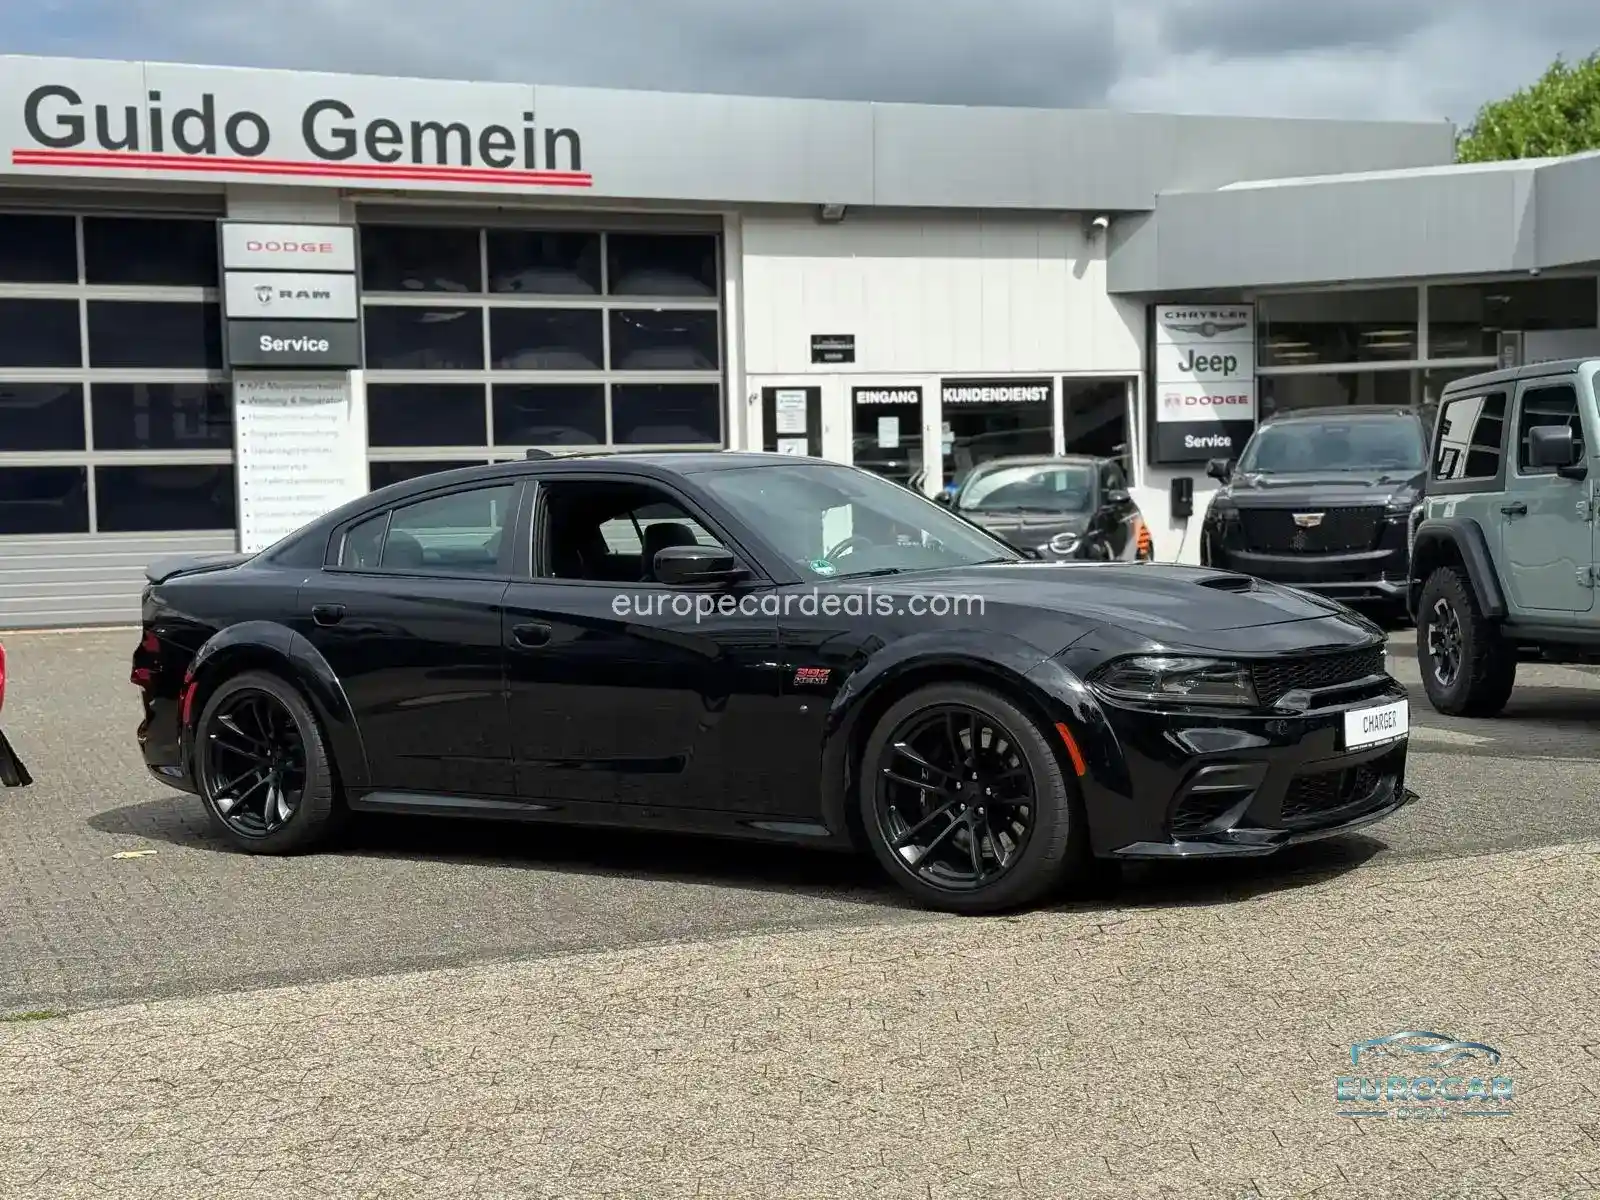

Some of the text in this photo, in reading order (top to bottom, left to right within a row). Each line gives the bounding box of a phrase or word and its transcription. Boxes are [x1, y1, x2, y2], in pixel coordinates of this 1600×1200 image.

[24, 84, 582, 170] Guido Gemein
[246, 241, 334, 253] DODGE
[279, 289, 331, 300] RAM
[1164, 310, 1249, 320] CHRYSLER
[259, 335, 330, 352] Service
[1178, 349, 1238, 376] Jeep
[856, 390, 918, 404] EINGANG
[942, 386, 1049, 403] KUNDENDIENST
[1185, 395, 1249, 406] DODGE
[1184, 434, 1232, 449] Service
[1363, 710, 1397, 733] CHARGER
